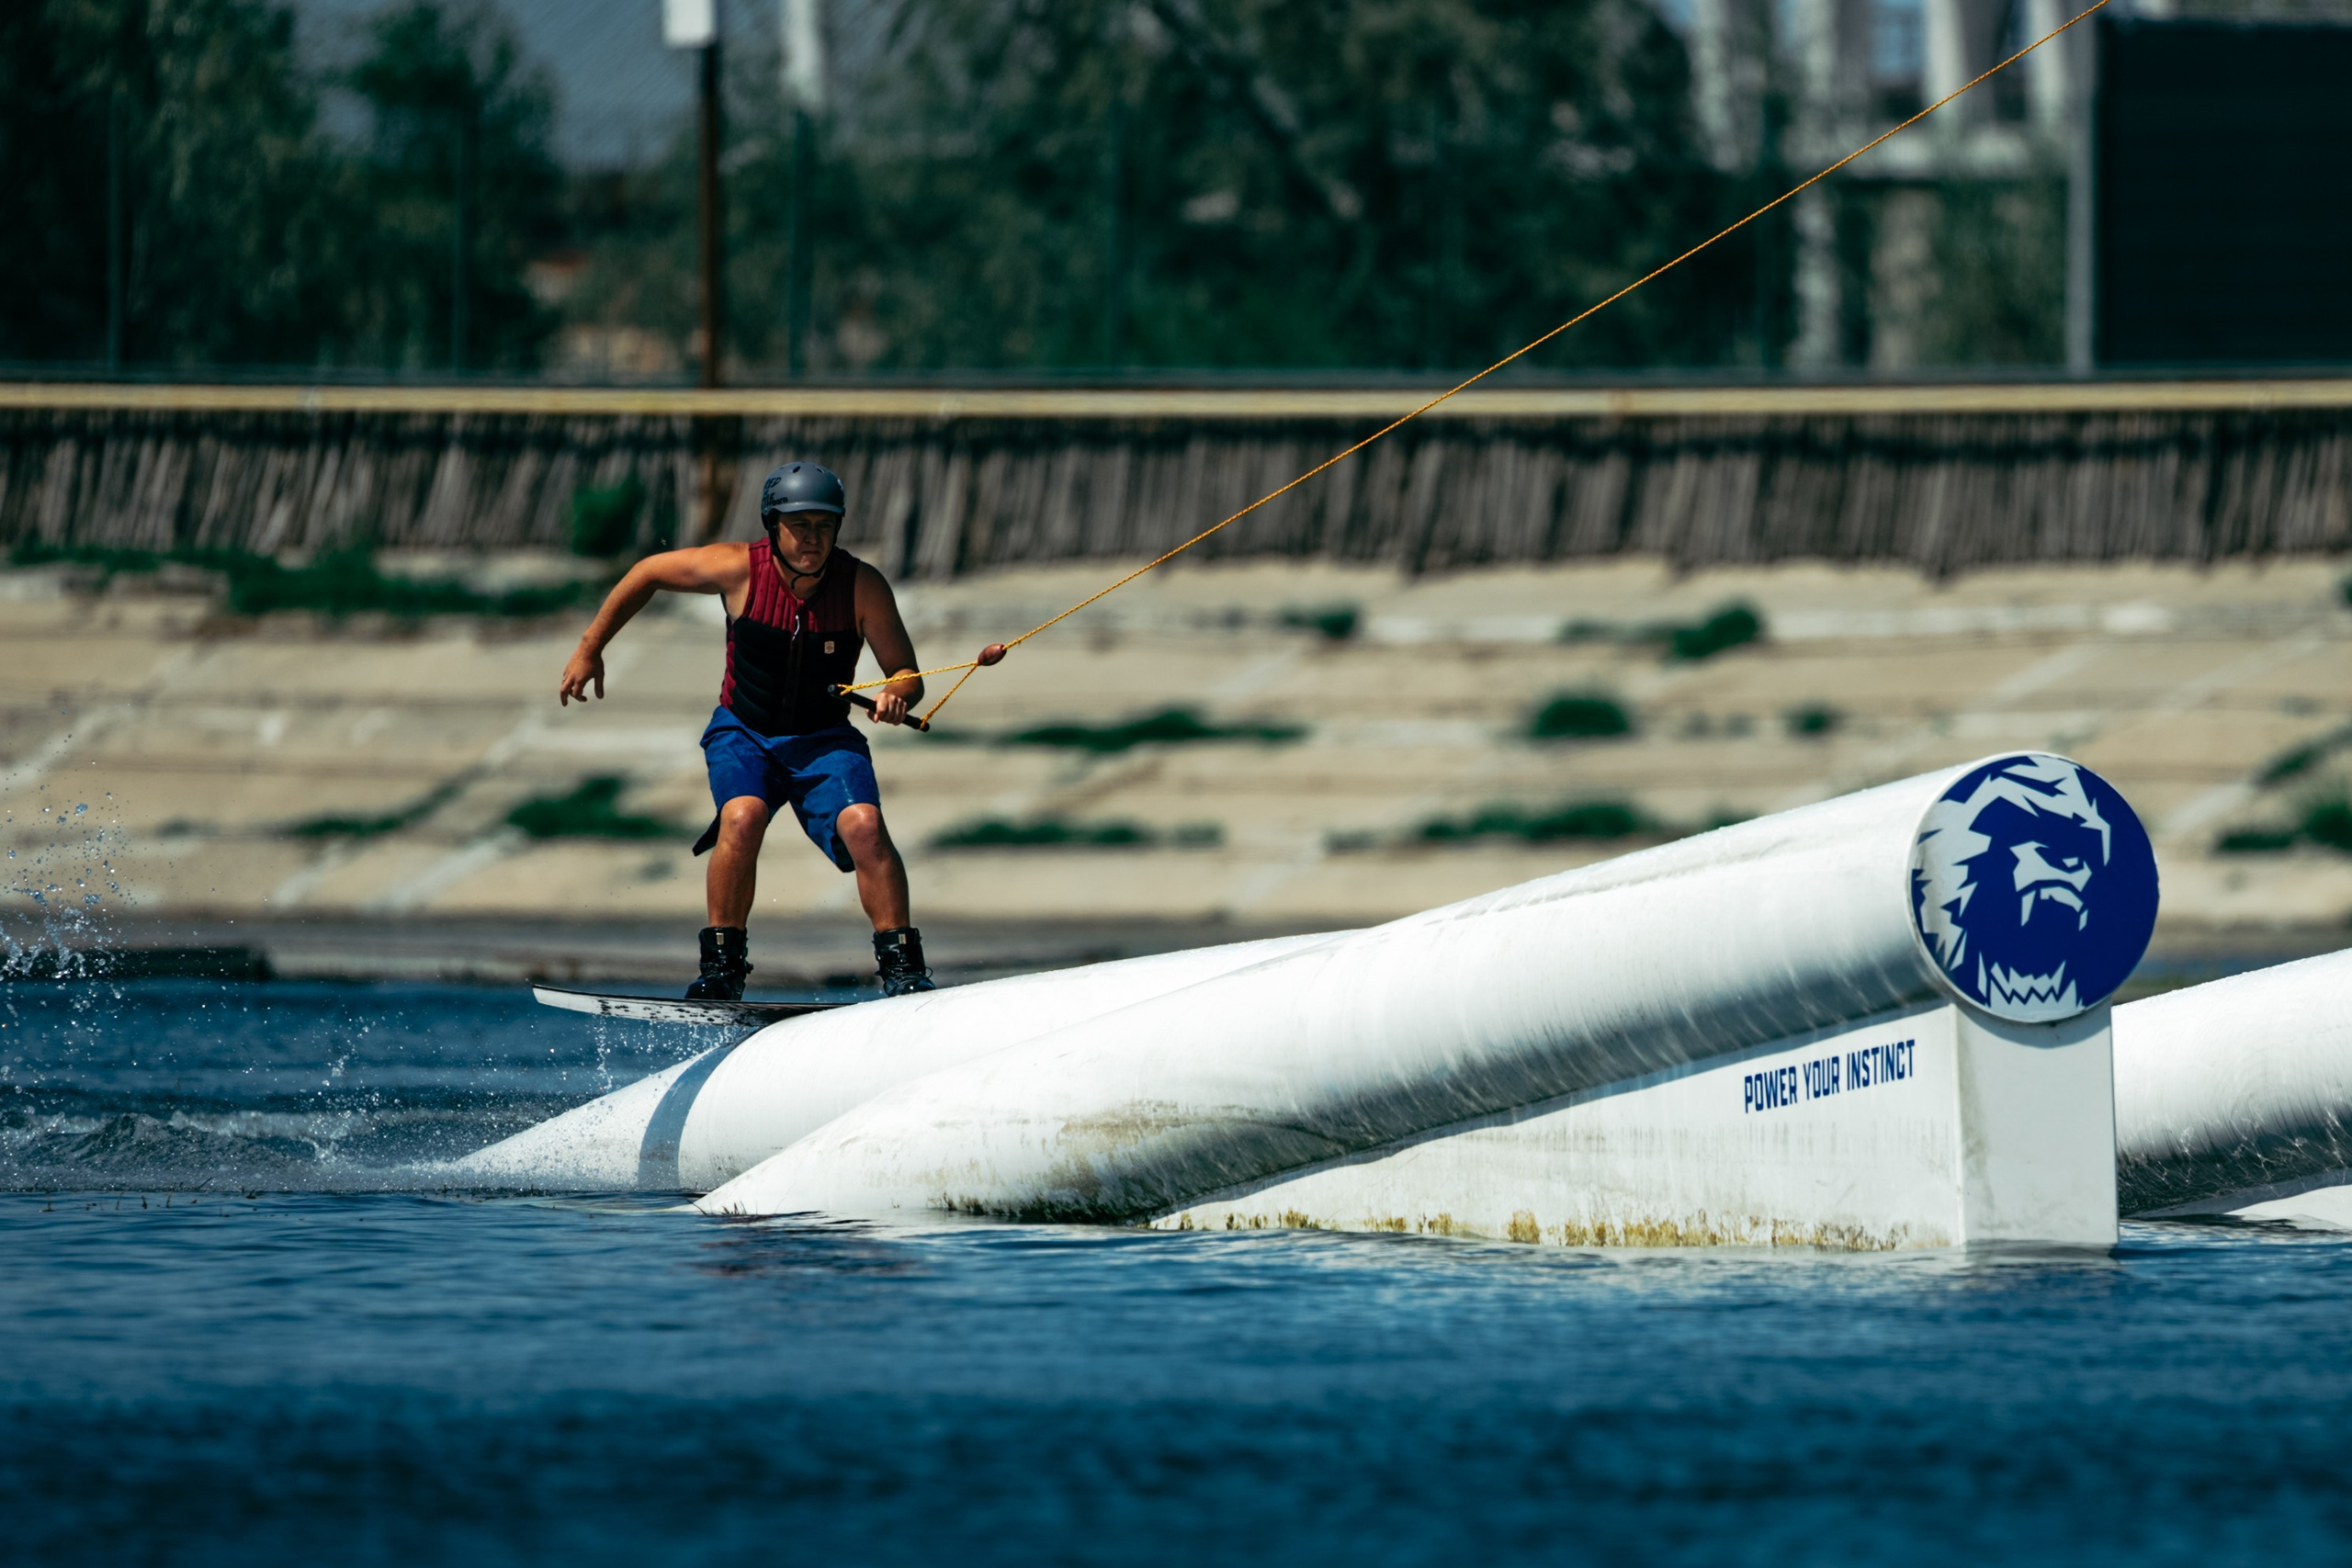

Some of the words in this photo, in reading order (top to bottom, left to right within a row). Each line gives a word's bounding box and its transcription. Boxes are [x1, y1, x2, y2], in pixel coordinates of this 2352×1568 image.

[1744, 1066, 1798, 1114] POWER
[1803, 1055, 1840, 1100] YOUR
[1847, 1039, 1916, 1091] INSTINCT
